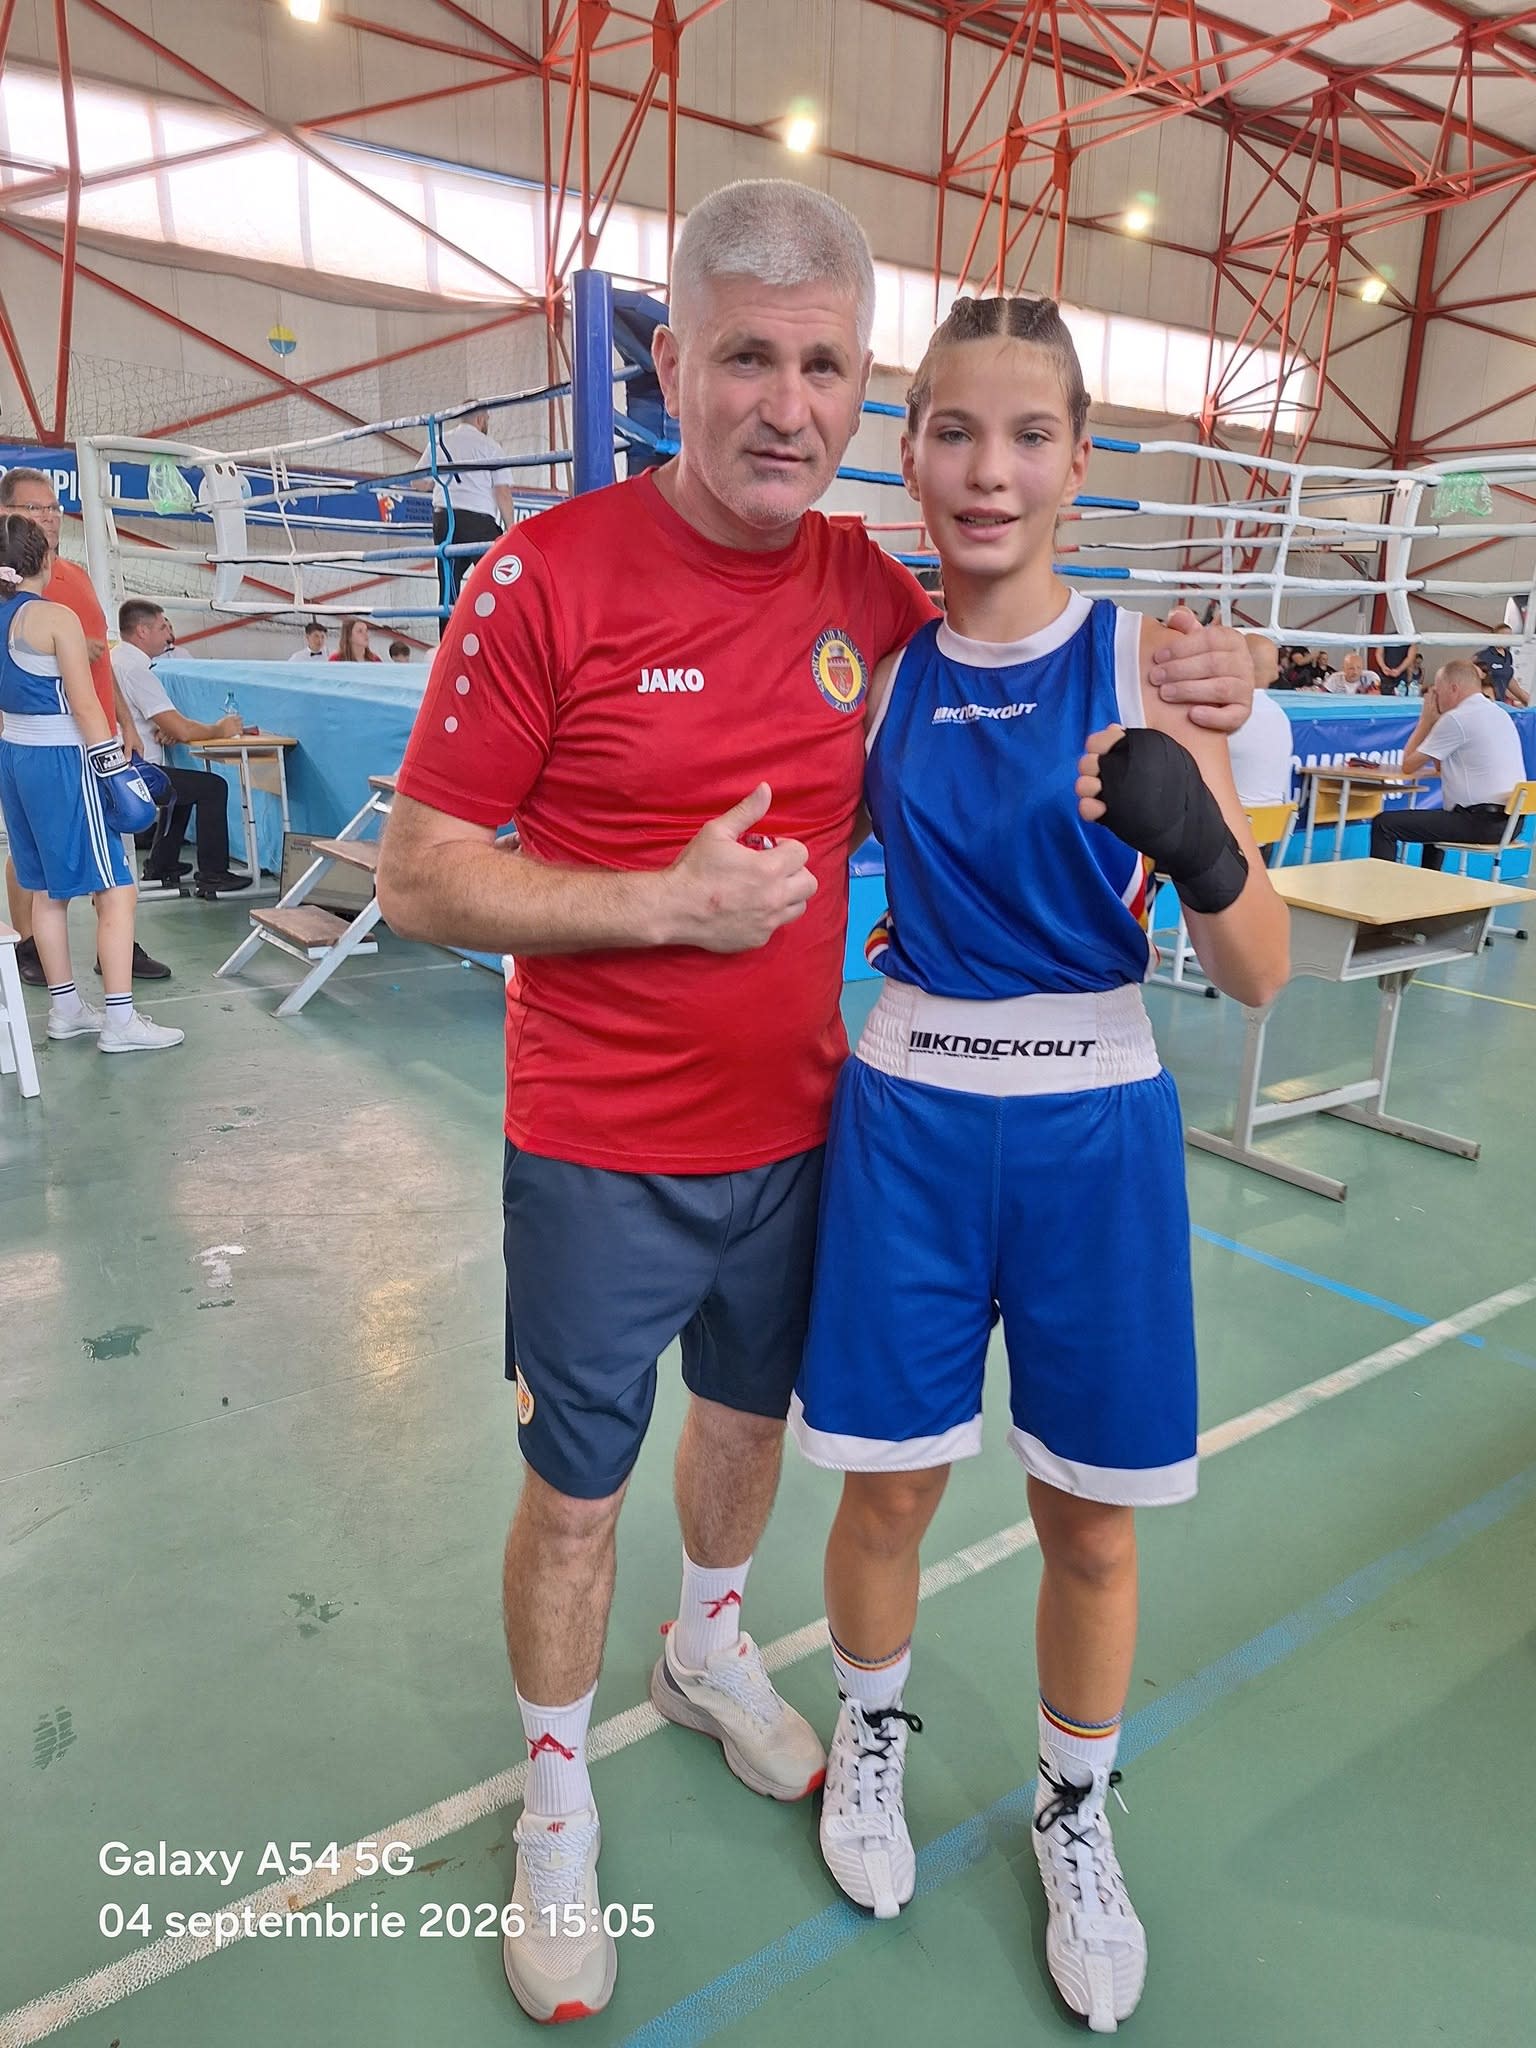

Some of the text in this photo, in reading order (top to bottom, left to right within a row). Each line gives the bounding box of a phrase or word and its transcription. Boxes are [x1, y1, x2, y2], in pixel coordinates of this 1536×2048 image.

[637, 668, 705, 693] JAKO
[946, 703, 1038, 720] KNOCKOUT
[932, 1033, 1096, 1057] KNOCKOUT
